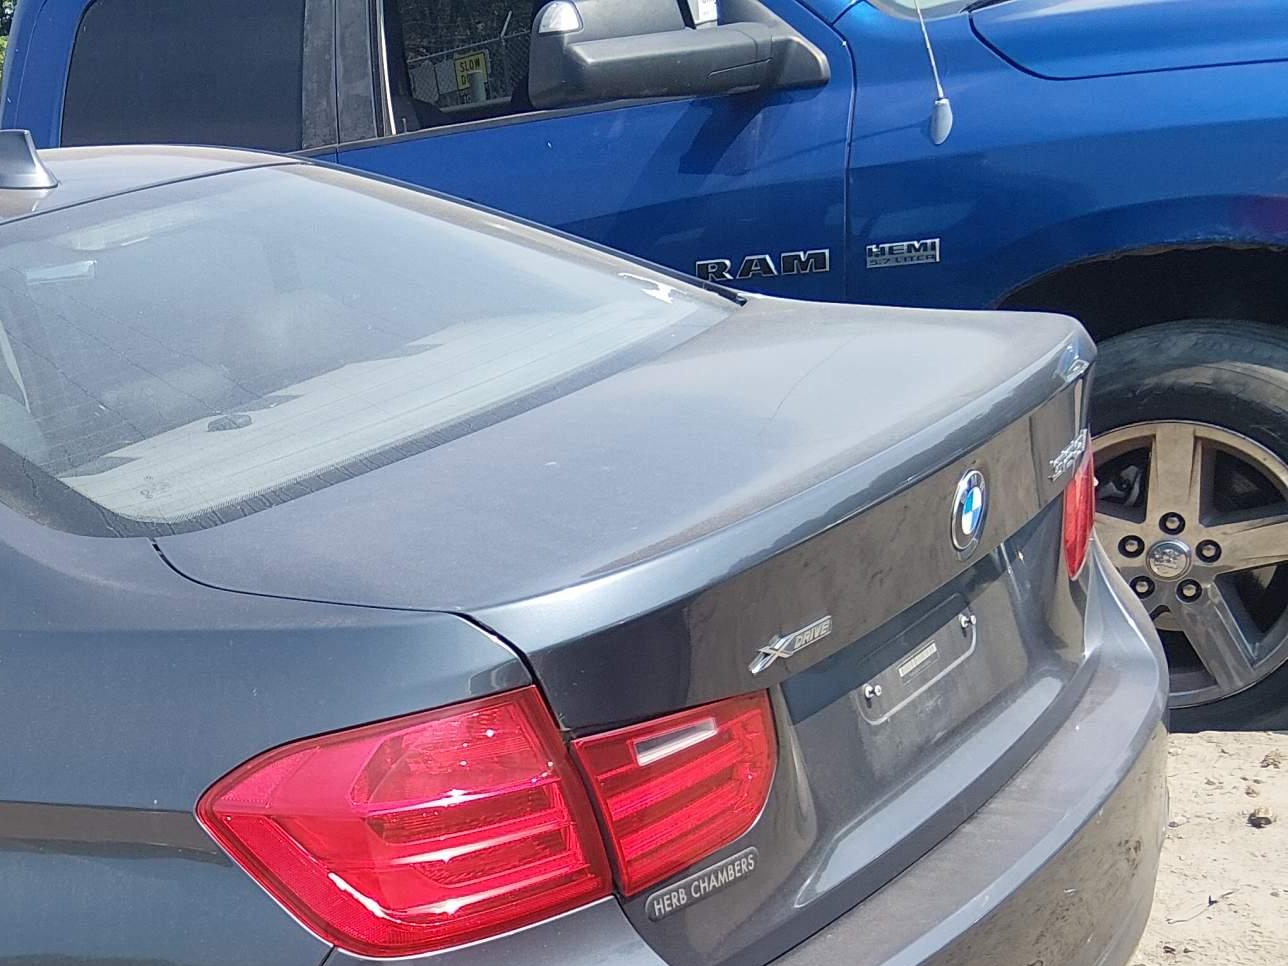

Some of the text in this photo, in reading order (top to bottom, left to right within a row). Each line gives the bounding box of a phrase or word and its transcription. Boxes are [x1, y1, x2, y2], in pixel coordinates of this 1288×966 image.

[866, 239, 938, 257] HEMI
[696, 249, 830, 281] RAM
[653, 854, 756, 917] HERB CHAMBERS
